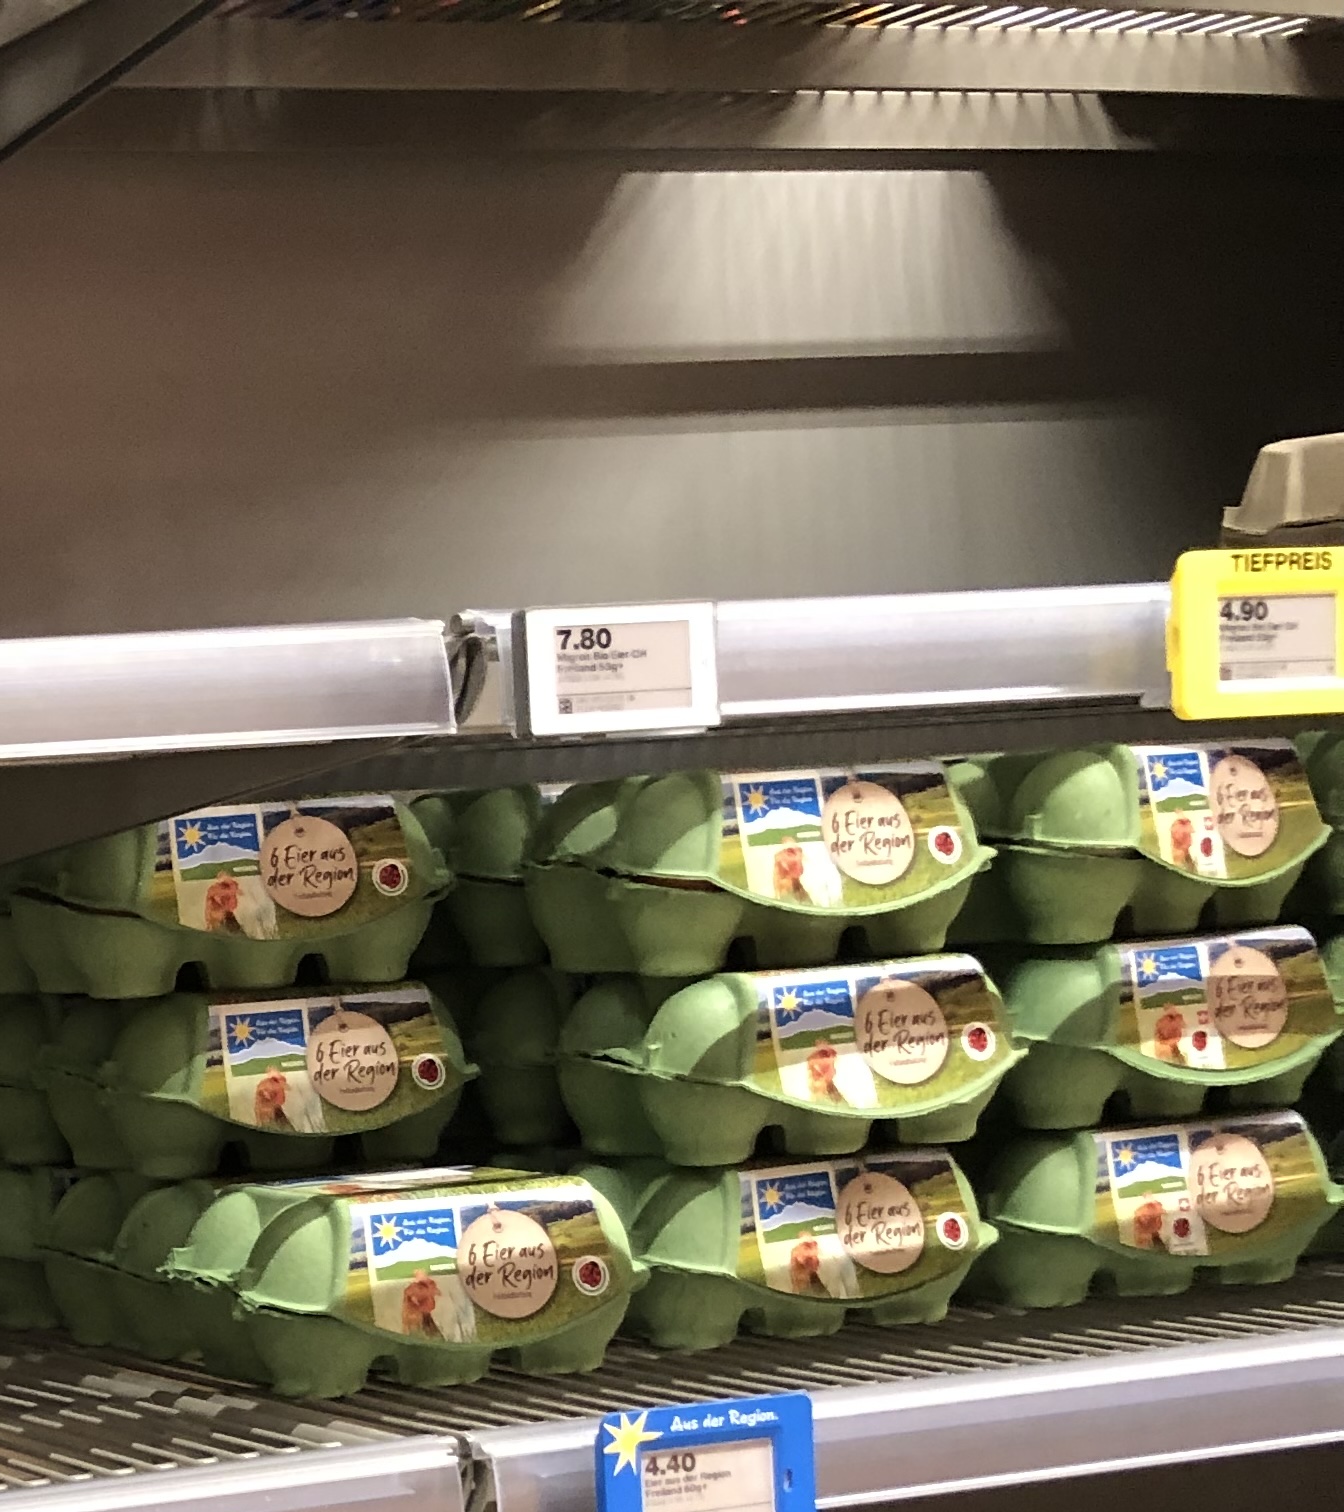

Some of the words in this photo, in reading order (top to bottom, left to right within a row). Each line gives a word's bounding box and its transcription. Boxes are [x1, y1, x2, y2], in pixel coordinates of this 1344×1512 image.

[1230, 551, 1333, 572] TIEFPREIS
[1220, 601, 1268, 621] 4.90
[556, 628, 612, 650] 7.80
[831, 812, 839, 833] 6
[844, 809, 874, 835] Eier
[877, 811, 901, 829] aus
[831, 835, 854, 856] der
[859, 832, 911, 856] Region
[270, 849, 279, 868] 6
[282, 845, 317, 870] Eier
[320, 846, 345, 862] aus
[267, 869, 294, 889] der
[300, 868, 355, 888] Region
[865, 1013, 873, 1033] 6
[877, 1010, 906, 1029] Eier
[911, 1011, 935, 1026] aus
[315, 1041, 324, 1063] 6
[328, 1039, 359, 1064] Eier
[363, 1040, 387, 1056] aus
[864, 1036, 888, 1057] der
[893, 1030, 945, 1056] Region
[314, 1063, 338, 1083] der
[343, 1060, 396, 1083] Region
[845, 1204, 852, 1224] 6
[857, 1202, 883, 1227] Eier
[888, 1202, 912, 1219] aus
[843, 1226, 866, 1247] der
[872, 1222, 920, 1247] Region
[468, 1245, 477, 1266] 6
[482, 1240, 515, 1268] Eier
[520, 1242, 545, 1259] aus
[465, 1266, 492, 1290] der
[498, 1262, 554, 1290] Region
[670, 1415, 698, 1432] Aus
[703, 1414, 724, 1428] der
[728, 1409, 779, 1427] Region.
[645, 1453, 696, 1475] 4.40
